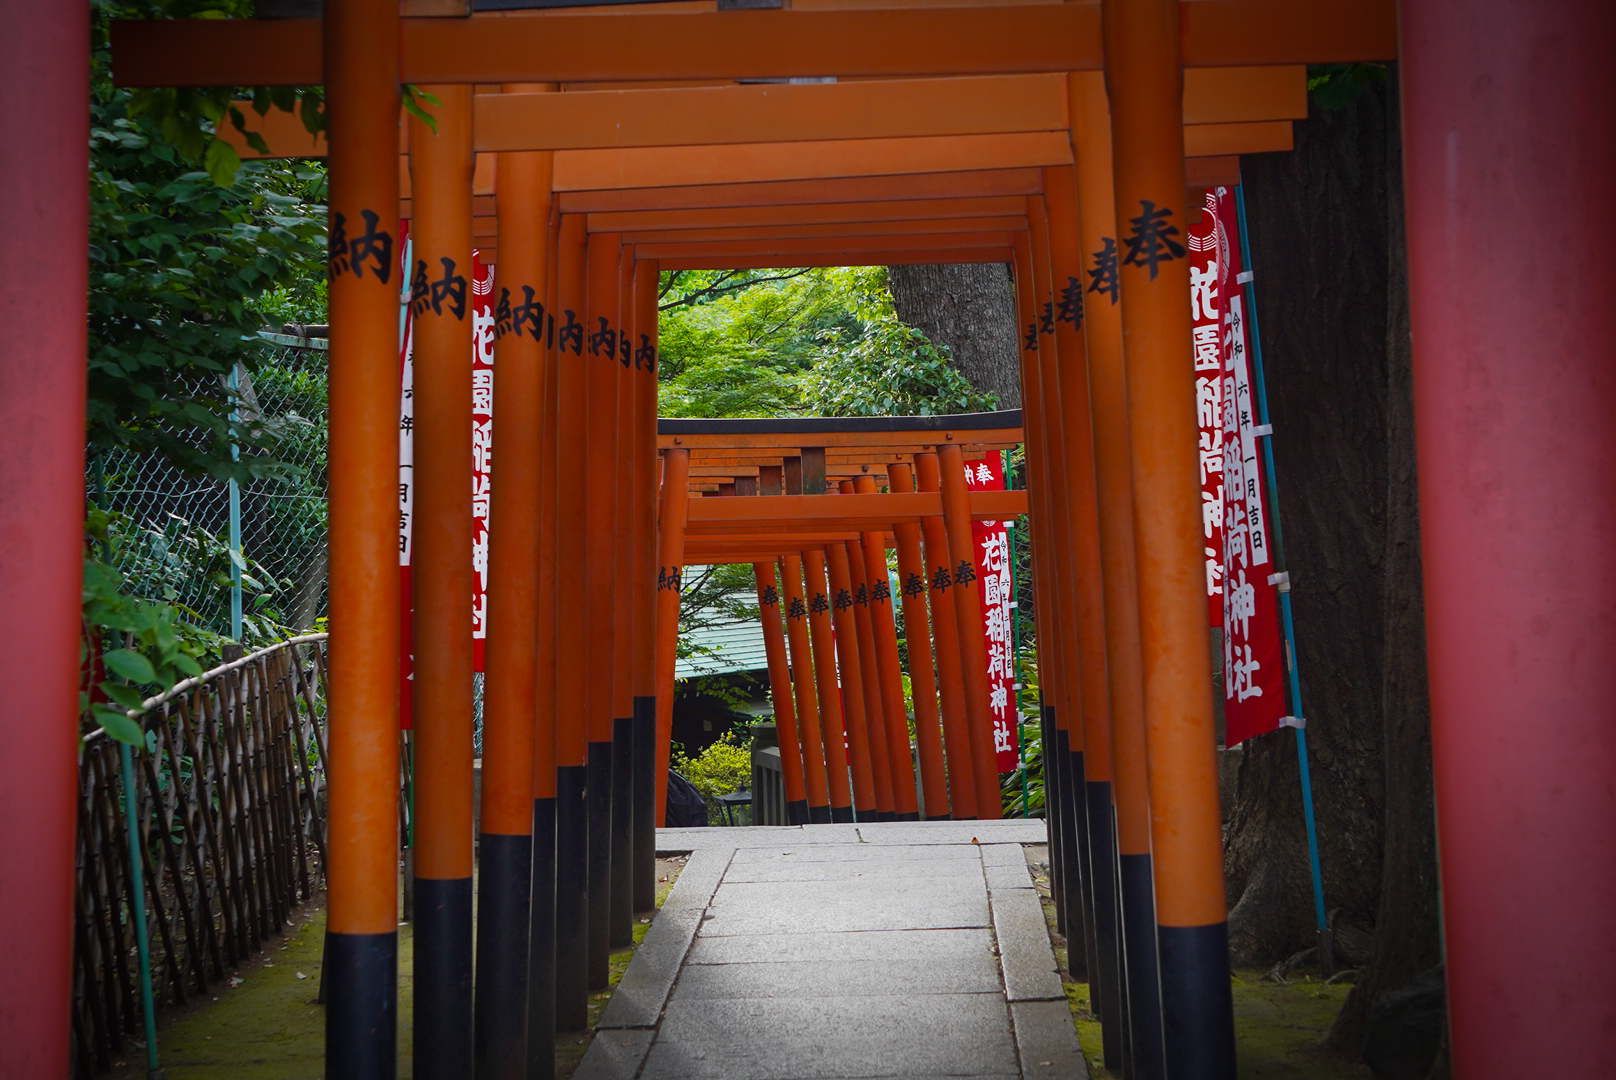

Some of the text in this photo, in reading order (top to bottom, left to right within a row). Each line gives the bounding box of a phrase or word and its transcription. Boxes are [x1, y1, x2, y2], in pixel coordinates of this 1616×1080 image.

[328, 209, 393, 285] 納
[1123, 200, 1187, 281] 奉
[412, 256, 468, 321] 納
[494, 285, 545, 343] 納
[903, 572, 925, 600] 奉
[931, 565, 953, 594] 奉
[954, 560, 977, 589] 奉
[761, 584, 779, 609] 奉
[810, 591, 830, 617] 奉
[834, 587, 853, 613] 奉
[871, 578, 892, 605] 奉
[788, 596, 807, 622] 奉
